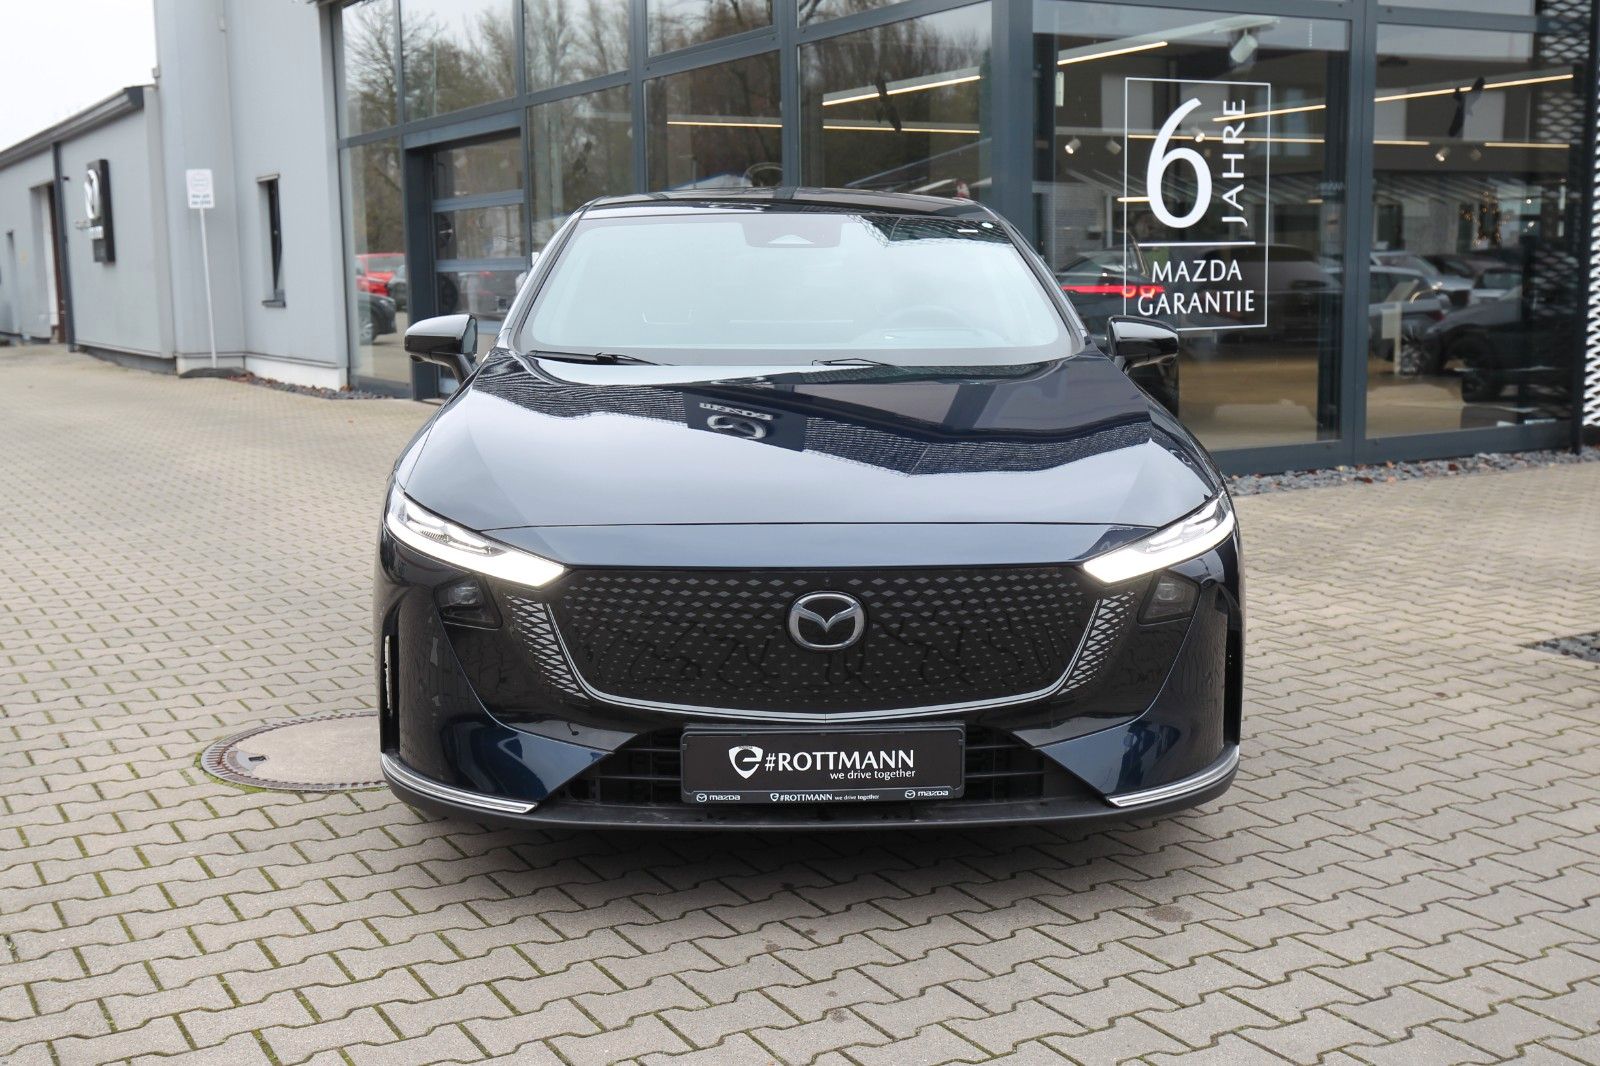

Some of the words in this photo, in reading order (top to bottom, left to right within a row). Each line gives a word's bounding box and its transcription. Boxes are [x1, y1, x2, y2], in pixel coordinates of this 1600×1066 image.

[1147, 98, 1213, 229] 6
[1222, 99, 1248, 227] JAHRE
[1152, 259, 1243, 283] MAZDA
[1138, 290, 1255, 316] GARANTIE
[765, 750, 914, 771] #ROTTMANN
[848, 770, 871, 779] drive
[874, 769, 916, 781] together
[780, 793, 833, 802] #ROTTMANN
